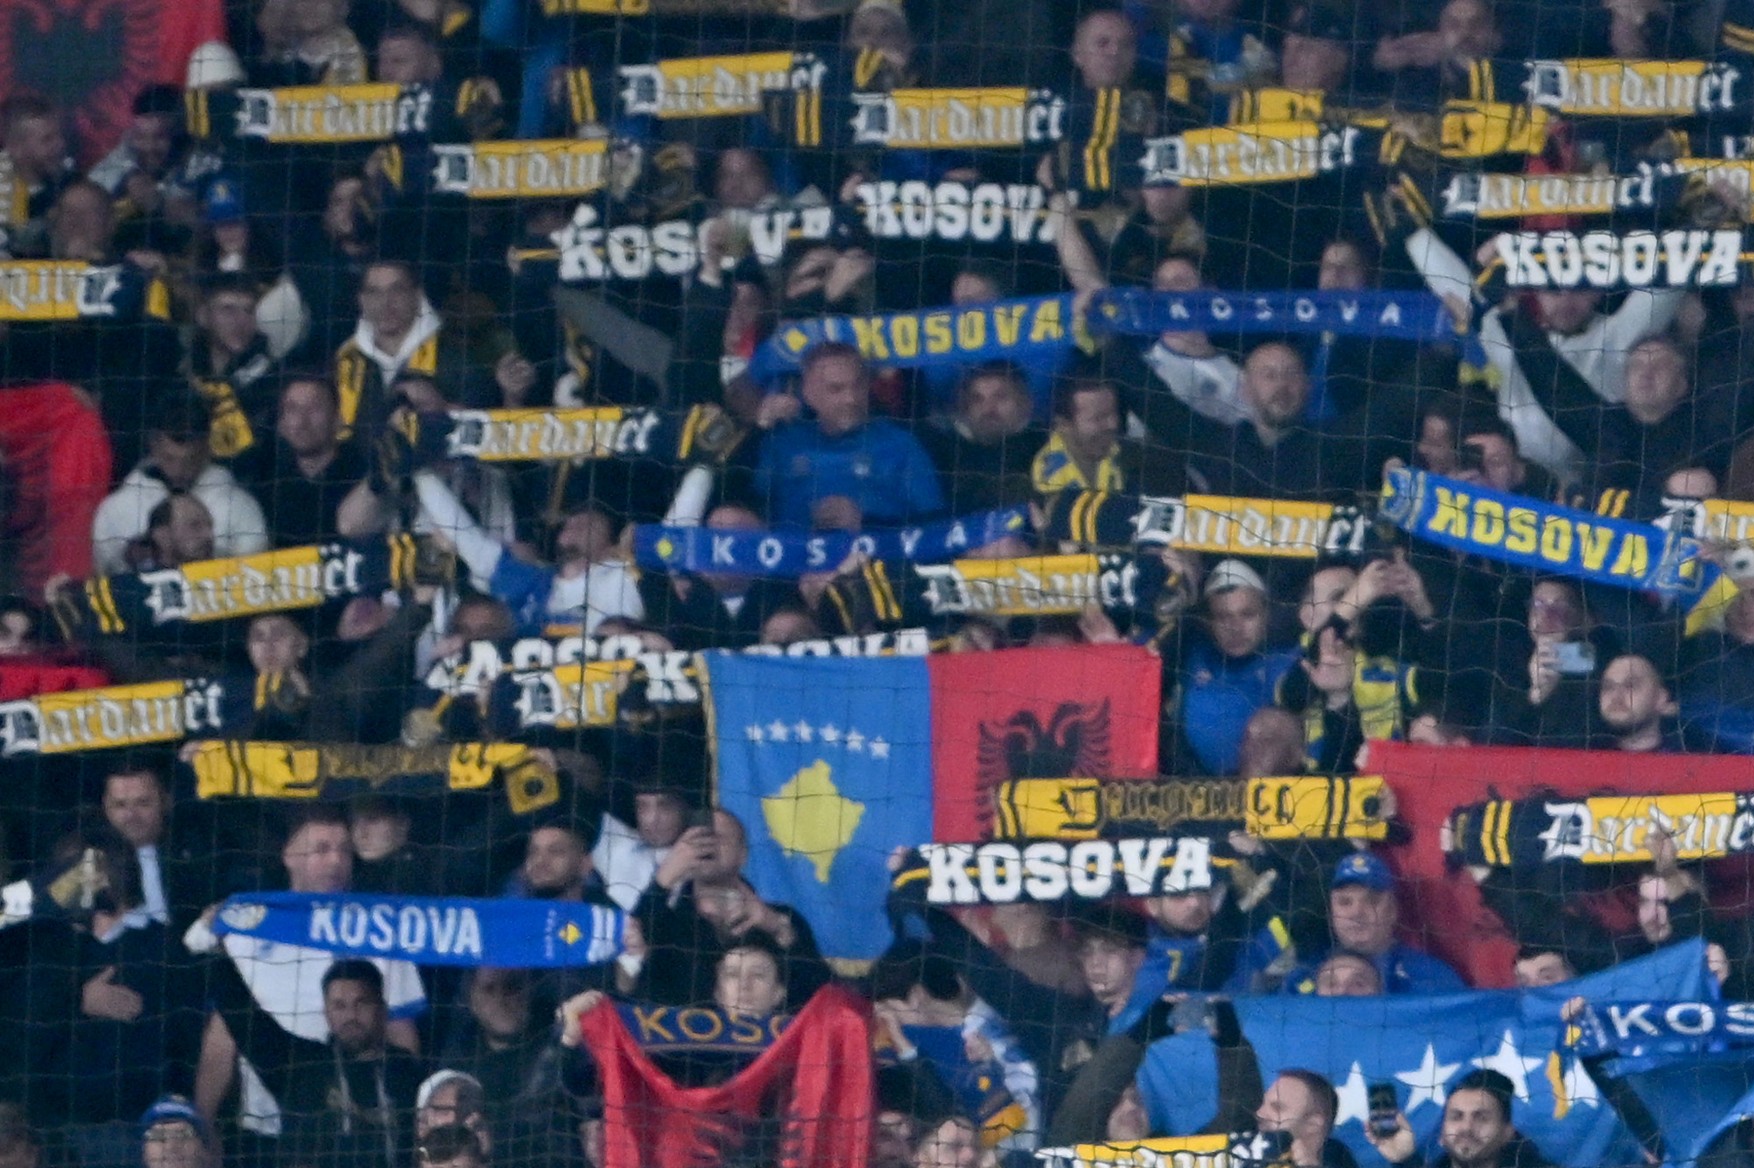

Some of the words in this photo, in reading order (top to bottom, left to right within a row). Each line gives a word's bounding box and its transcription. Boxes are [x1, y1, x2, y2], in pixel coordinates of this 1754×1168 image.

[1495, 229, 1741, 286] KOSOVA
[850, 300, 1066, 359] KOSOVA
[1428, 487, 1650, 578] KOSOVA
[920, 838, 1212, 902] KOSOVA
[310, 901, 482, 953] KOSOVA
